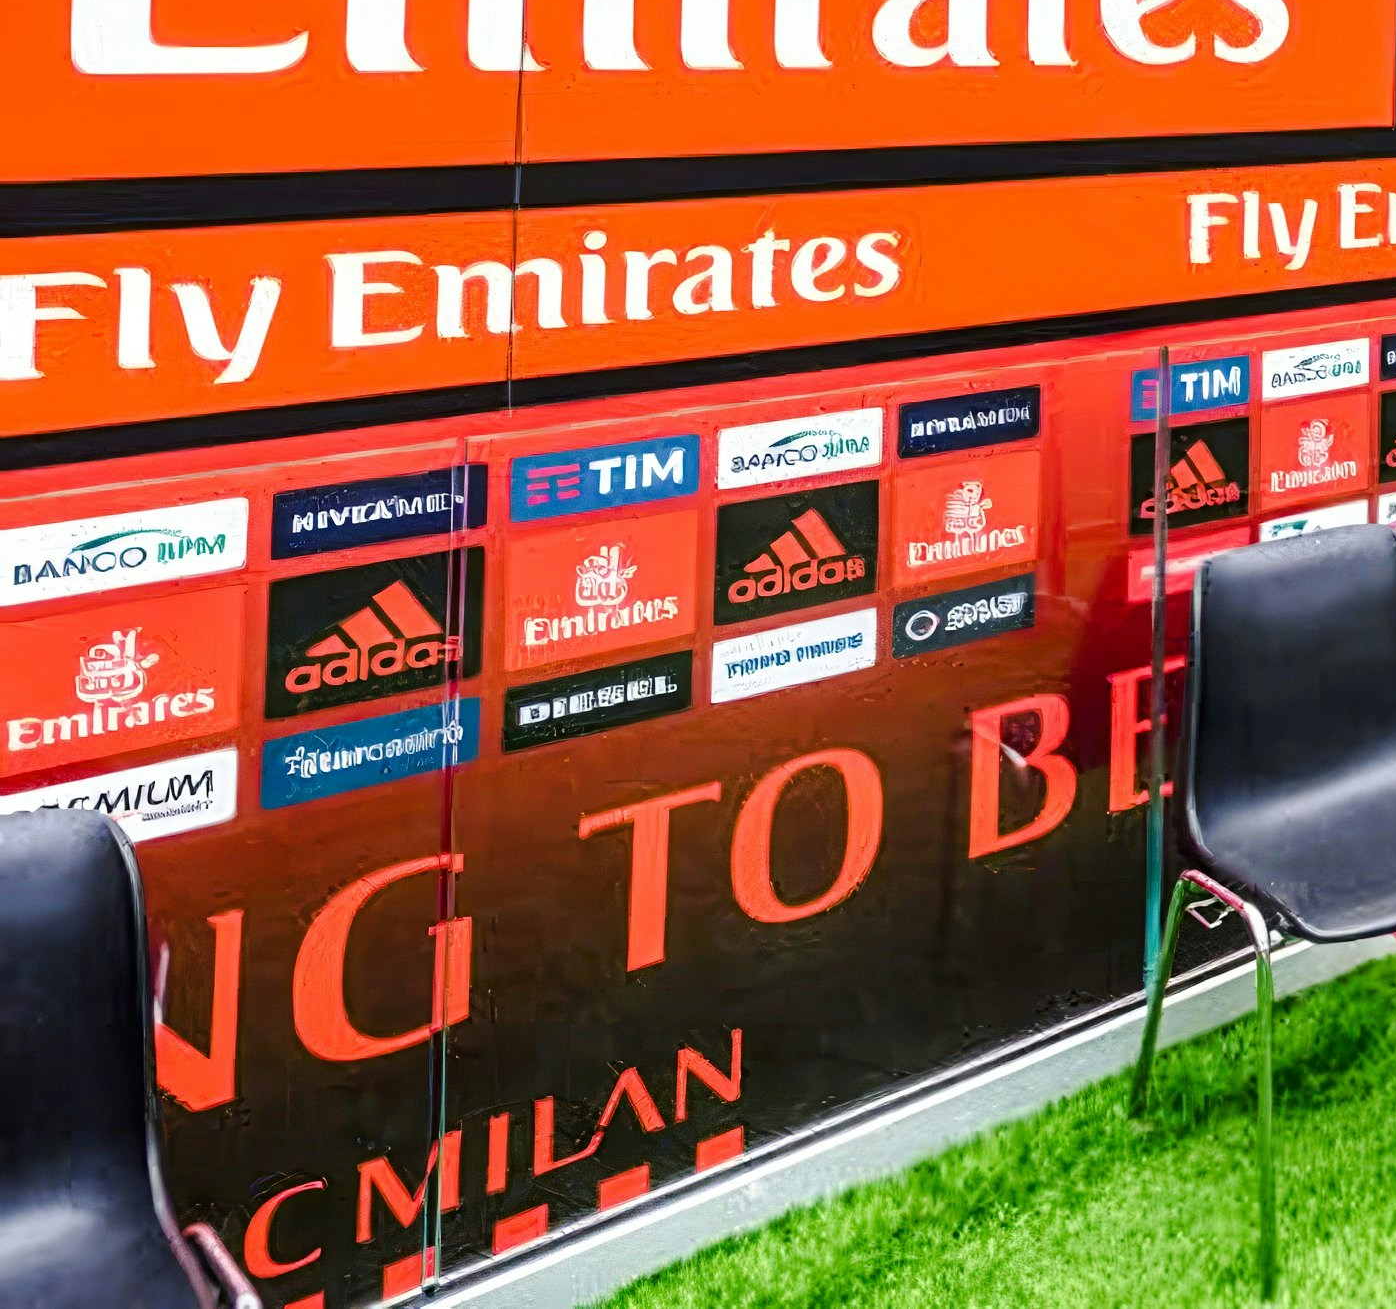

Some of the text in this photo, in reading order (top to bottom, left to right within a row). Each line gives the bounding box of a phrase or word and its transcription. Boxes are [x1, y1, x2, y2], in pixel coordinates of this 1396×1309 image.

[1187, 190, 1318, 271] Fly
[0, 228, 903, 385] Fly Emirates
[1181, 365, 1242, 403] TIM
[588, 446, 685, 495] TIM
[728, 556, 865, 605] adidas
[6, 686, 215, 752] Emirates
[578, 748, 884, 973] TO
[967, 655, 1186, 859] BE
